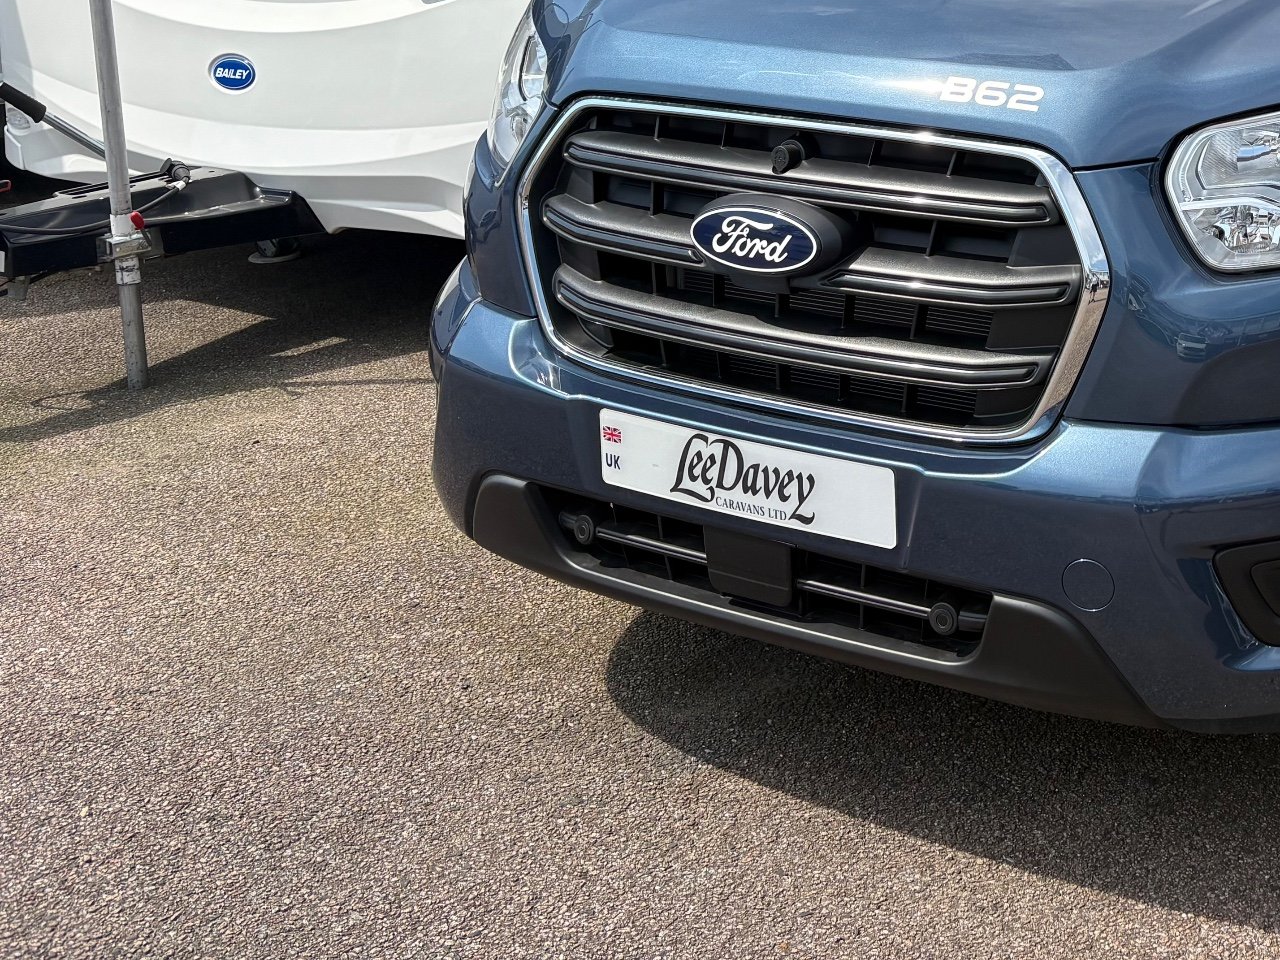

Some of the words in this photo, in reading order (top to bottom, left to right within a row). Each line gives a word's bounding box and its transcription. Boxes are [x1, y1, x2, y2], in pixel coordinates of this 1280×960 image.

[215, 67, 250, 80] BAILEY
[940, 76, 1045, 112] B62
[711, 215, 793, 263] Ford
[604, 452, 622, 471] UK
[715, 496, 765, 518] CARAVANS
[767, 507, 788, 521] LTD
